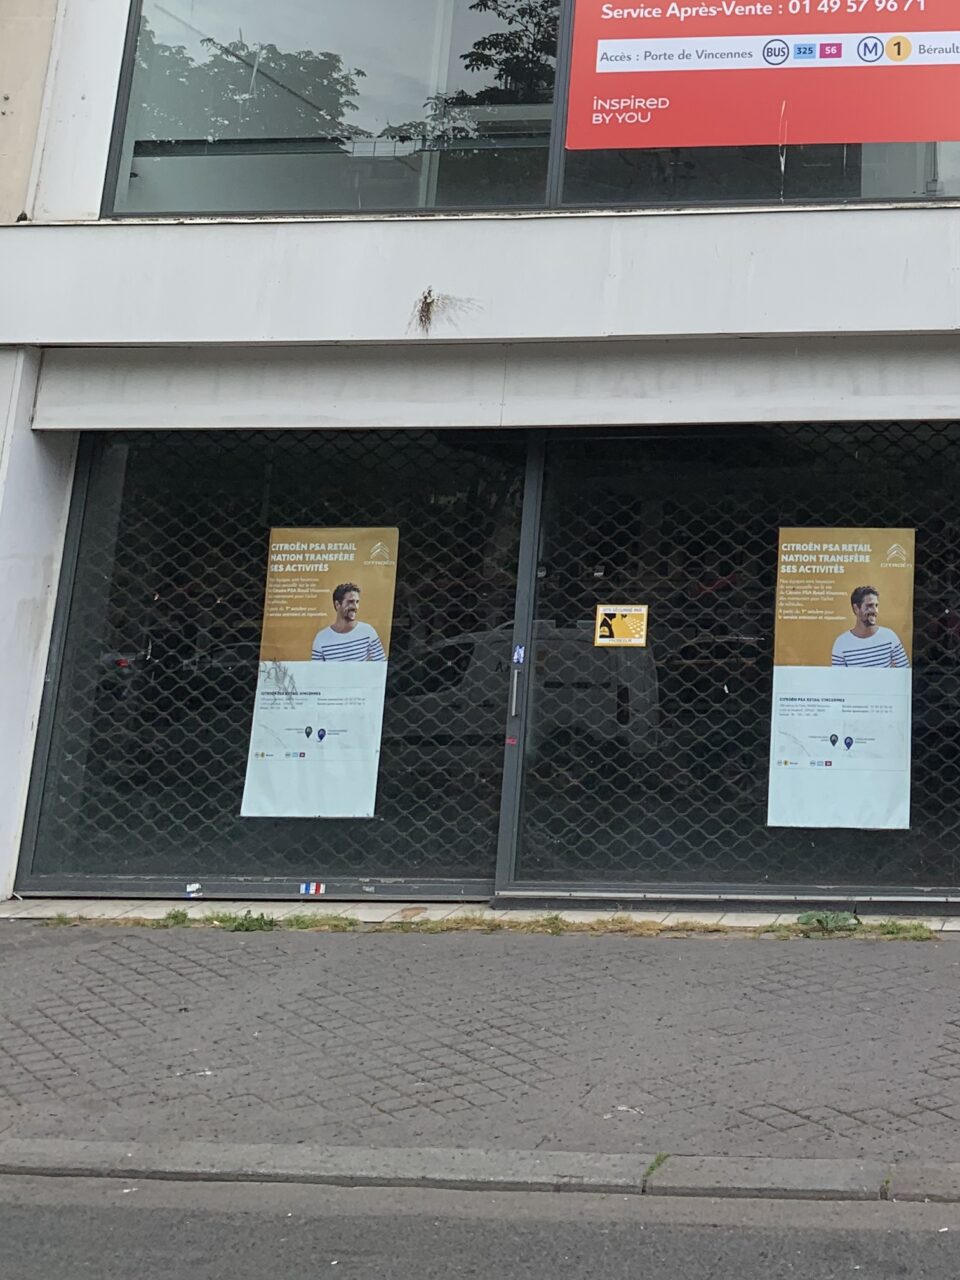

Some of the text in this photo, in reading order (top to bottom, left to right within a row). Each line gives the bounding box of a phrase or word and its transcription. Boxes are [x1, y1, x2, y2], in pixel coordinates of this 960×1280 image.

[601, 3, 662, 19] Service
[666, 1, 772, 21] Après-Vente
[789, 0, 810, 14] 01
[600, 50, 632, 63] Accès
[644, 50, 674, 62] Porte
[678, 48, 692, 61] de
[696, 47, 753, 60] Vincennes
[766, 46, 786, 58] BUS
[796, 46, 814, 55] 325
[824, 46, 837, 55] 56
[863, 43, 879, 56] M
[893, 41, 902, 55] 1
[919, 43, 960, 55] Bérault
[592, 111, 651, 124] BY YOU
[782, 542, 820, 551] CITROËN
[781, 554, 816, 562] NATION
[781, 565, 796, 573] SES
